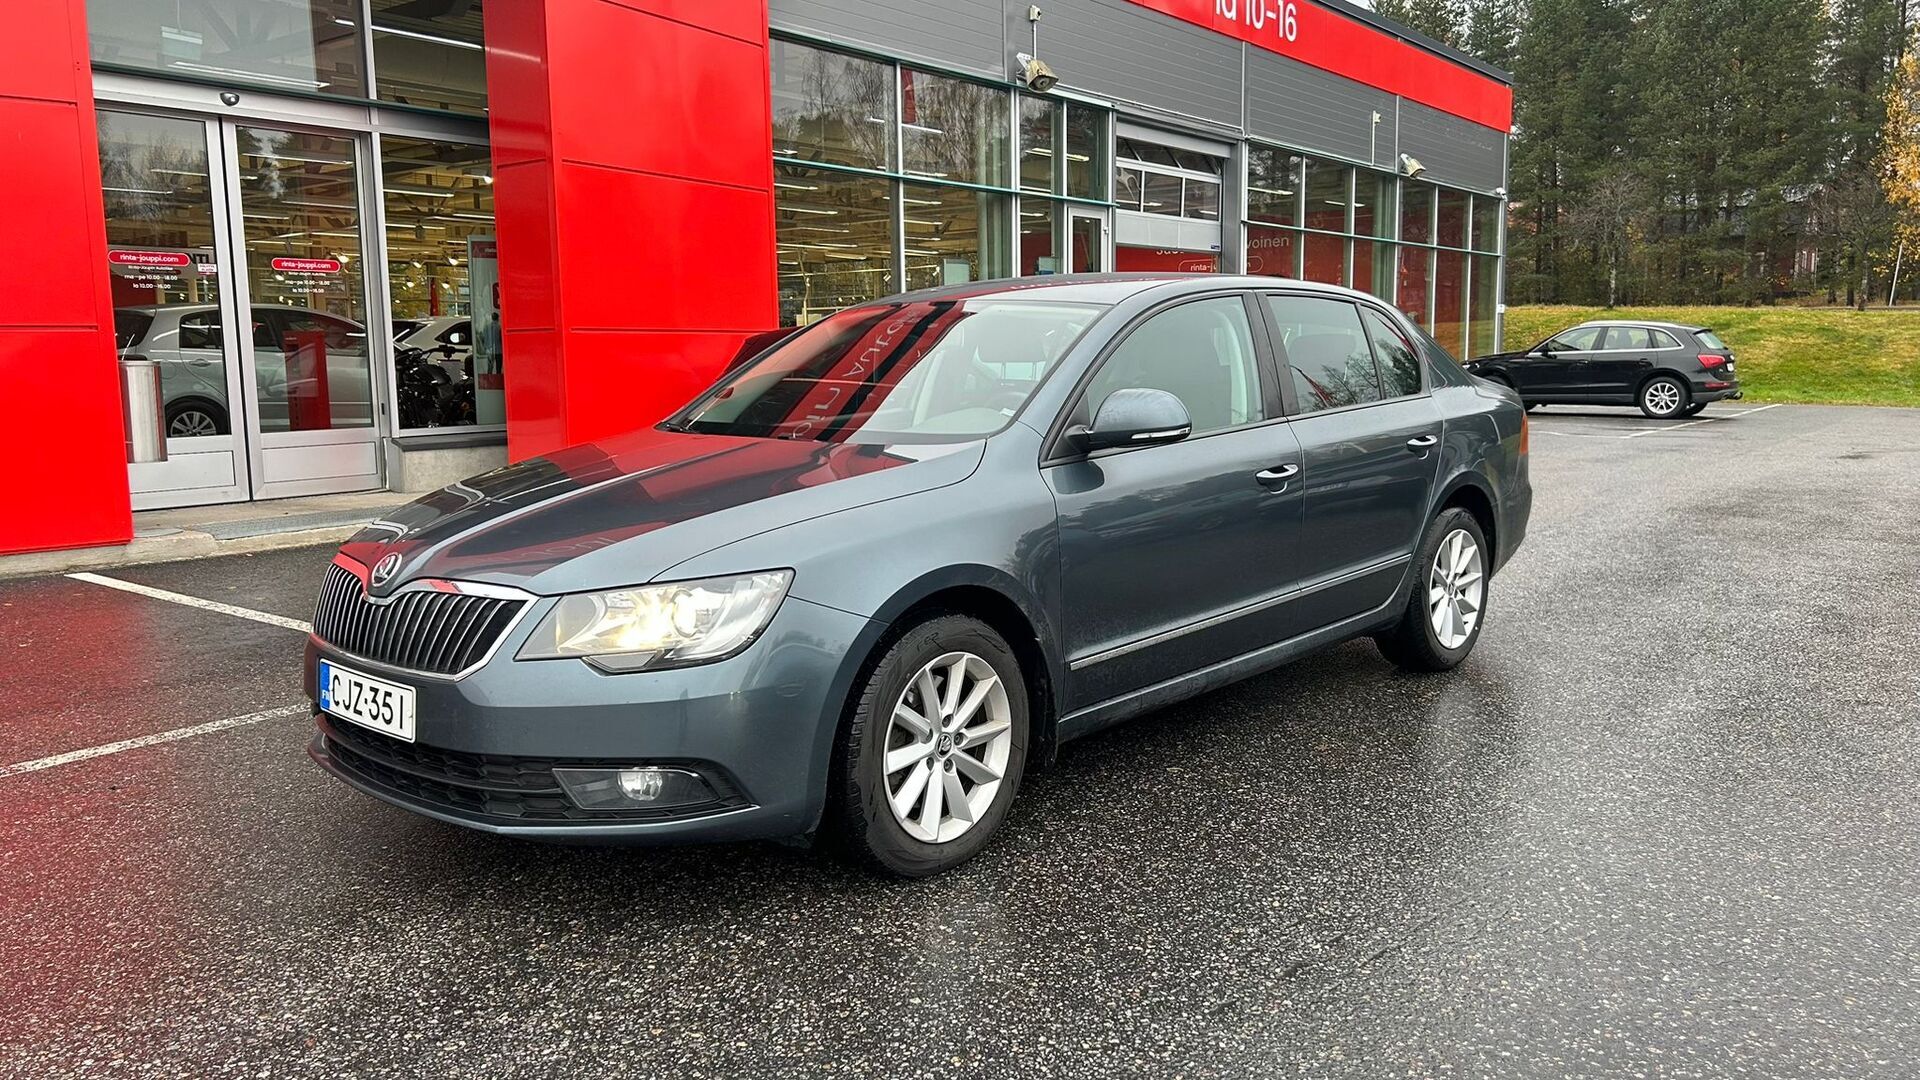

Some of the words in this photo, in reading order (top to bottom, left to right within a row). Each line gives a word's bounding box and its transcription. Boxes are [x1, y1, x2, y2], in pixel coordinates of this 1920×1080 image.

[1245, 0, 1297, 42] 10-16
[120, 254, 179, 263] rinta-jouppi.com
[281, 261, 332, 269] rinta-jouppi.com
[332, 674, 404, 730] CJZ-351
